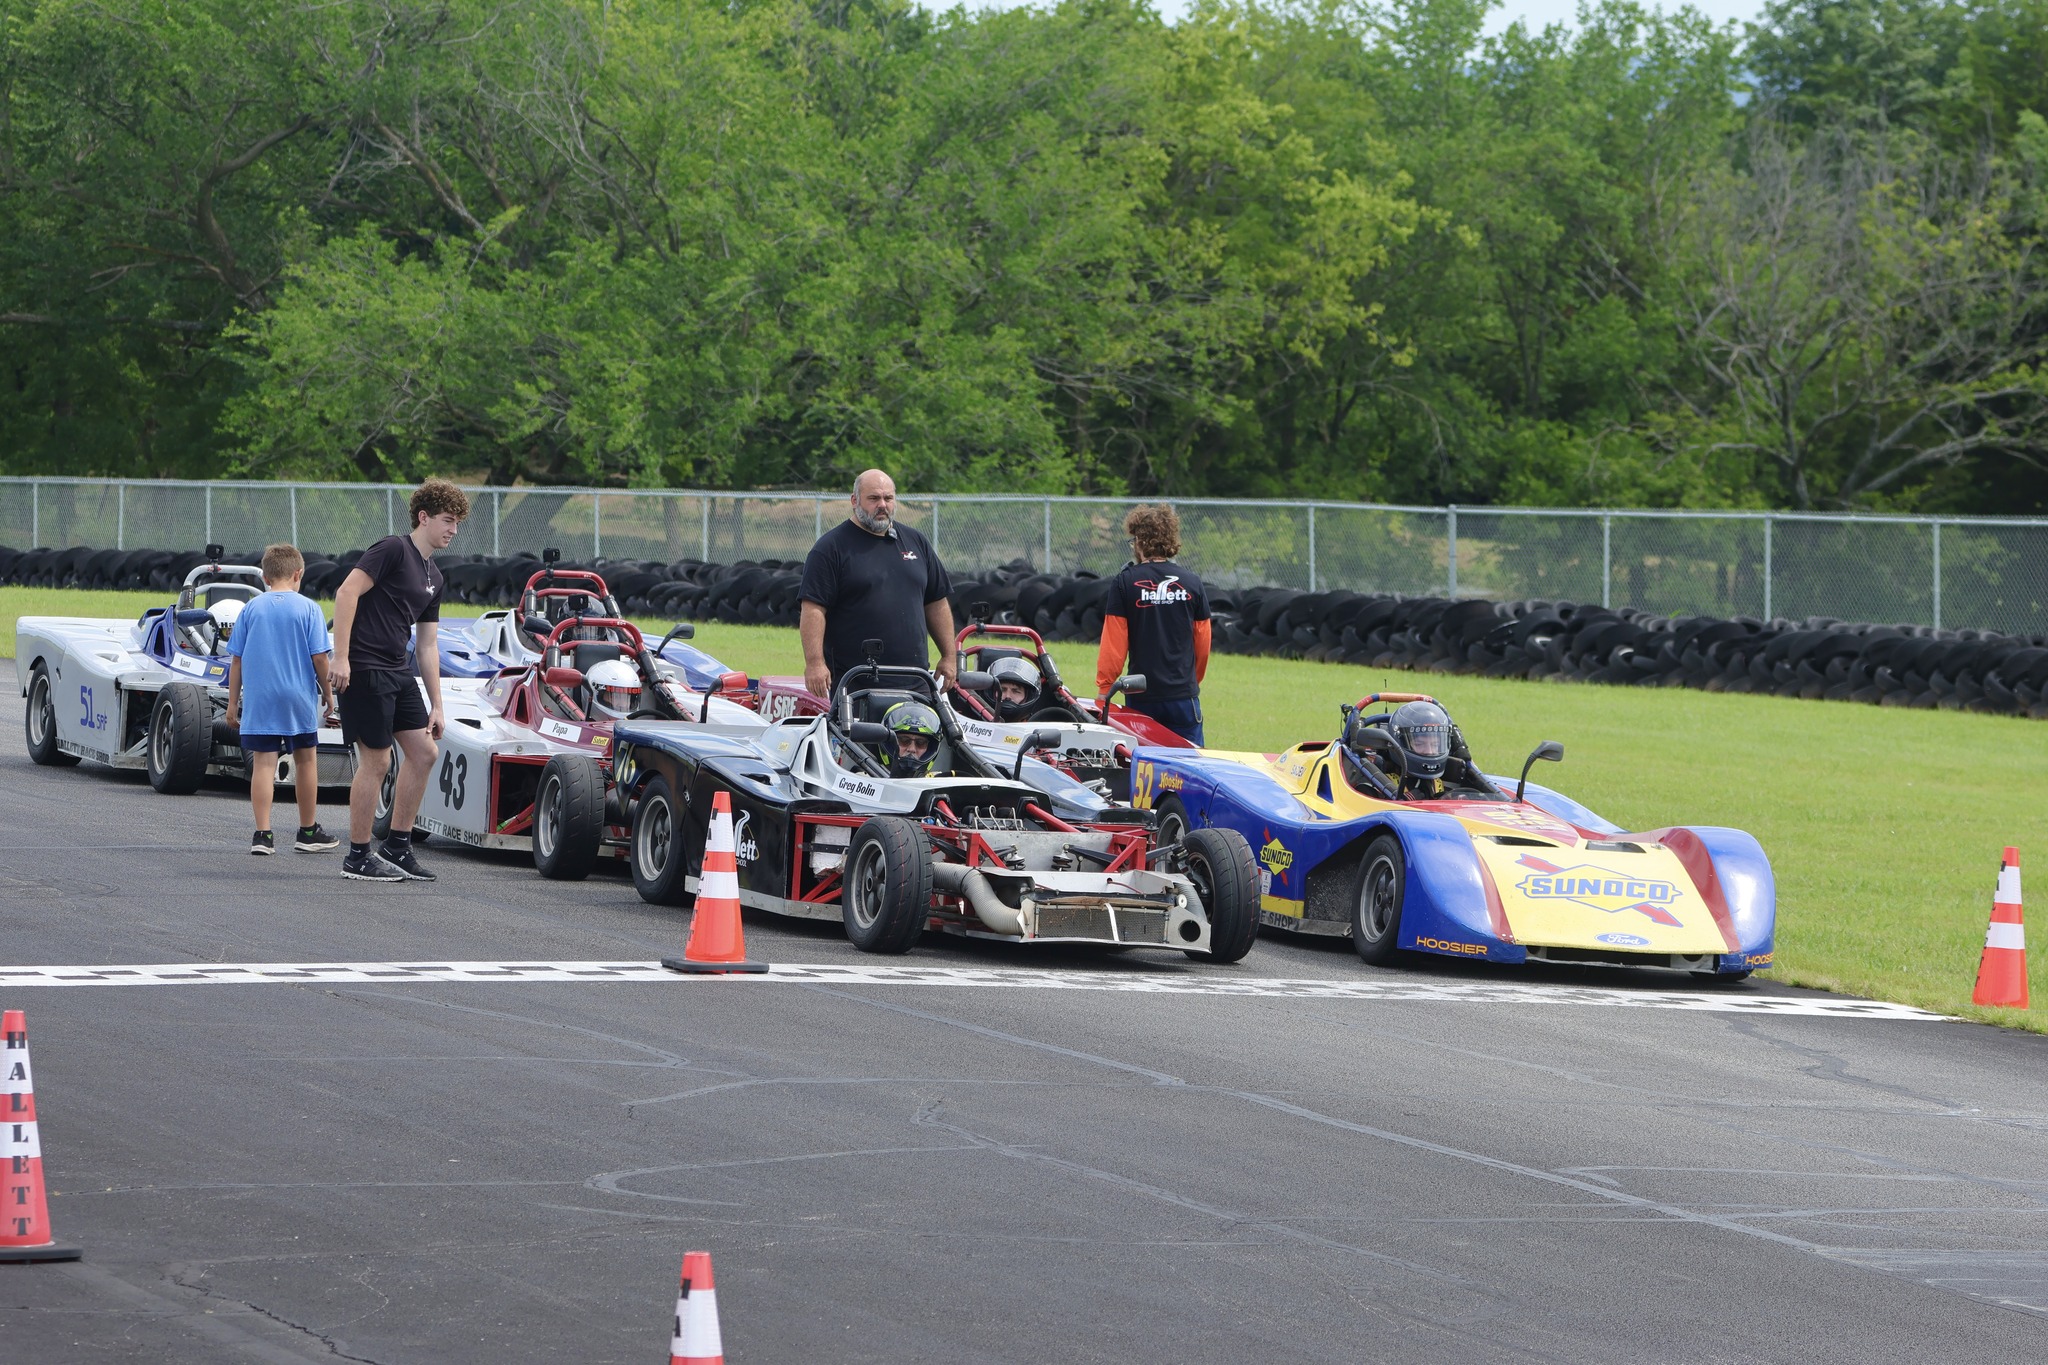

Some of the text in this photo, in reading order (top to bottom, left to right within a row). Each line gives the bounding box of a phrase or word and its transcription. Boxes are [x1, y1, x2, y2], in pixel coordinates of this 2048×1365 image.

[1141, 577, 1187, 601] hallett
[80, 685, 95, 729] 51
[760, 690, 798, 722] 4 SRF
[552, 722, 568, 736] Papa
[968, 723, 993, 737] Rogers
[615, 740, 637, 784] 76
[439, 749, 468, 811] 43
[838, 777, 876, 797] Greg Bolin
[1133, 760, 1154, 810] 52
[414, 815, 441, 833] ALLETT
[442, 823, 461, 840] RACE
[1261, 846, 1291, 867] SUNOCO
[1531, 877, 1669, 901] SUNOCO
[1269, 911, 1293, 929] SHOP
[1416, 935, 1488, 956] HOOSIER
[1607, 934, 1640, 946] Ford
[7, 1031, 31, 1237] HALLETT
